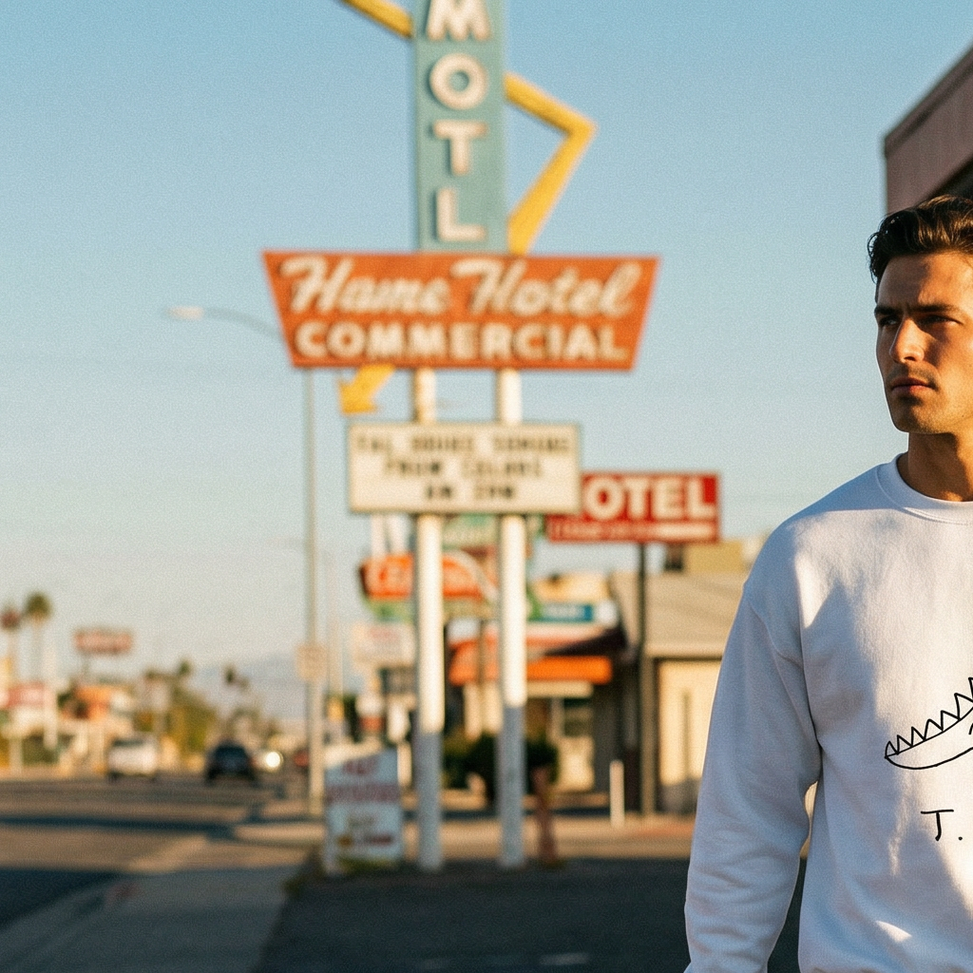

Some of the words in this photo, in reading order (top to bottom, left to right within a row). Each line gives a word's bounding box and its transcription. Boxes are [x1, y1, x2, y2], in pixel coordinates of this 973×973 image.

[450, 258, 641, 317] Hotel
[294, 320, 628, 362] COMMERCIAL
[583, 476, 717, 521] OTEL
